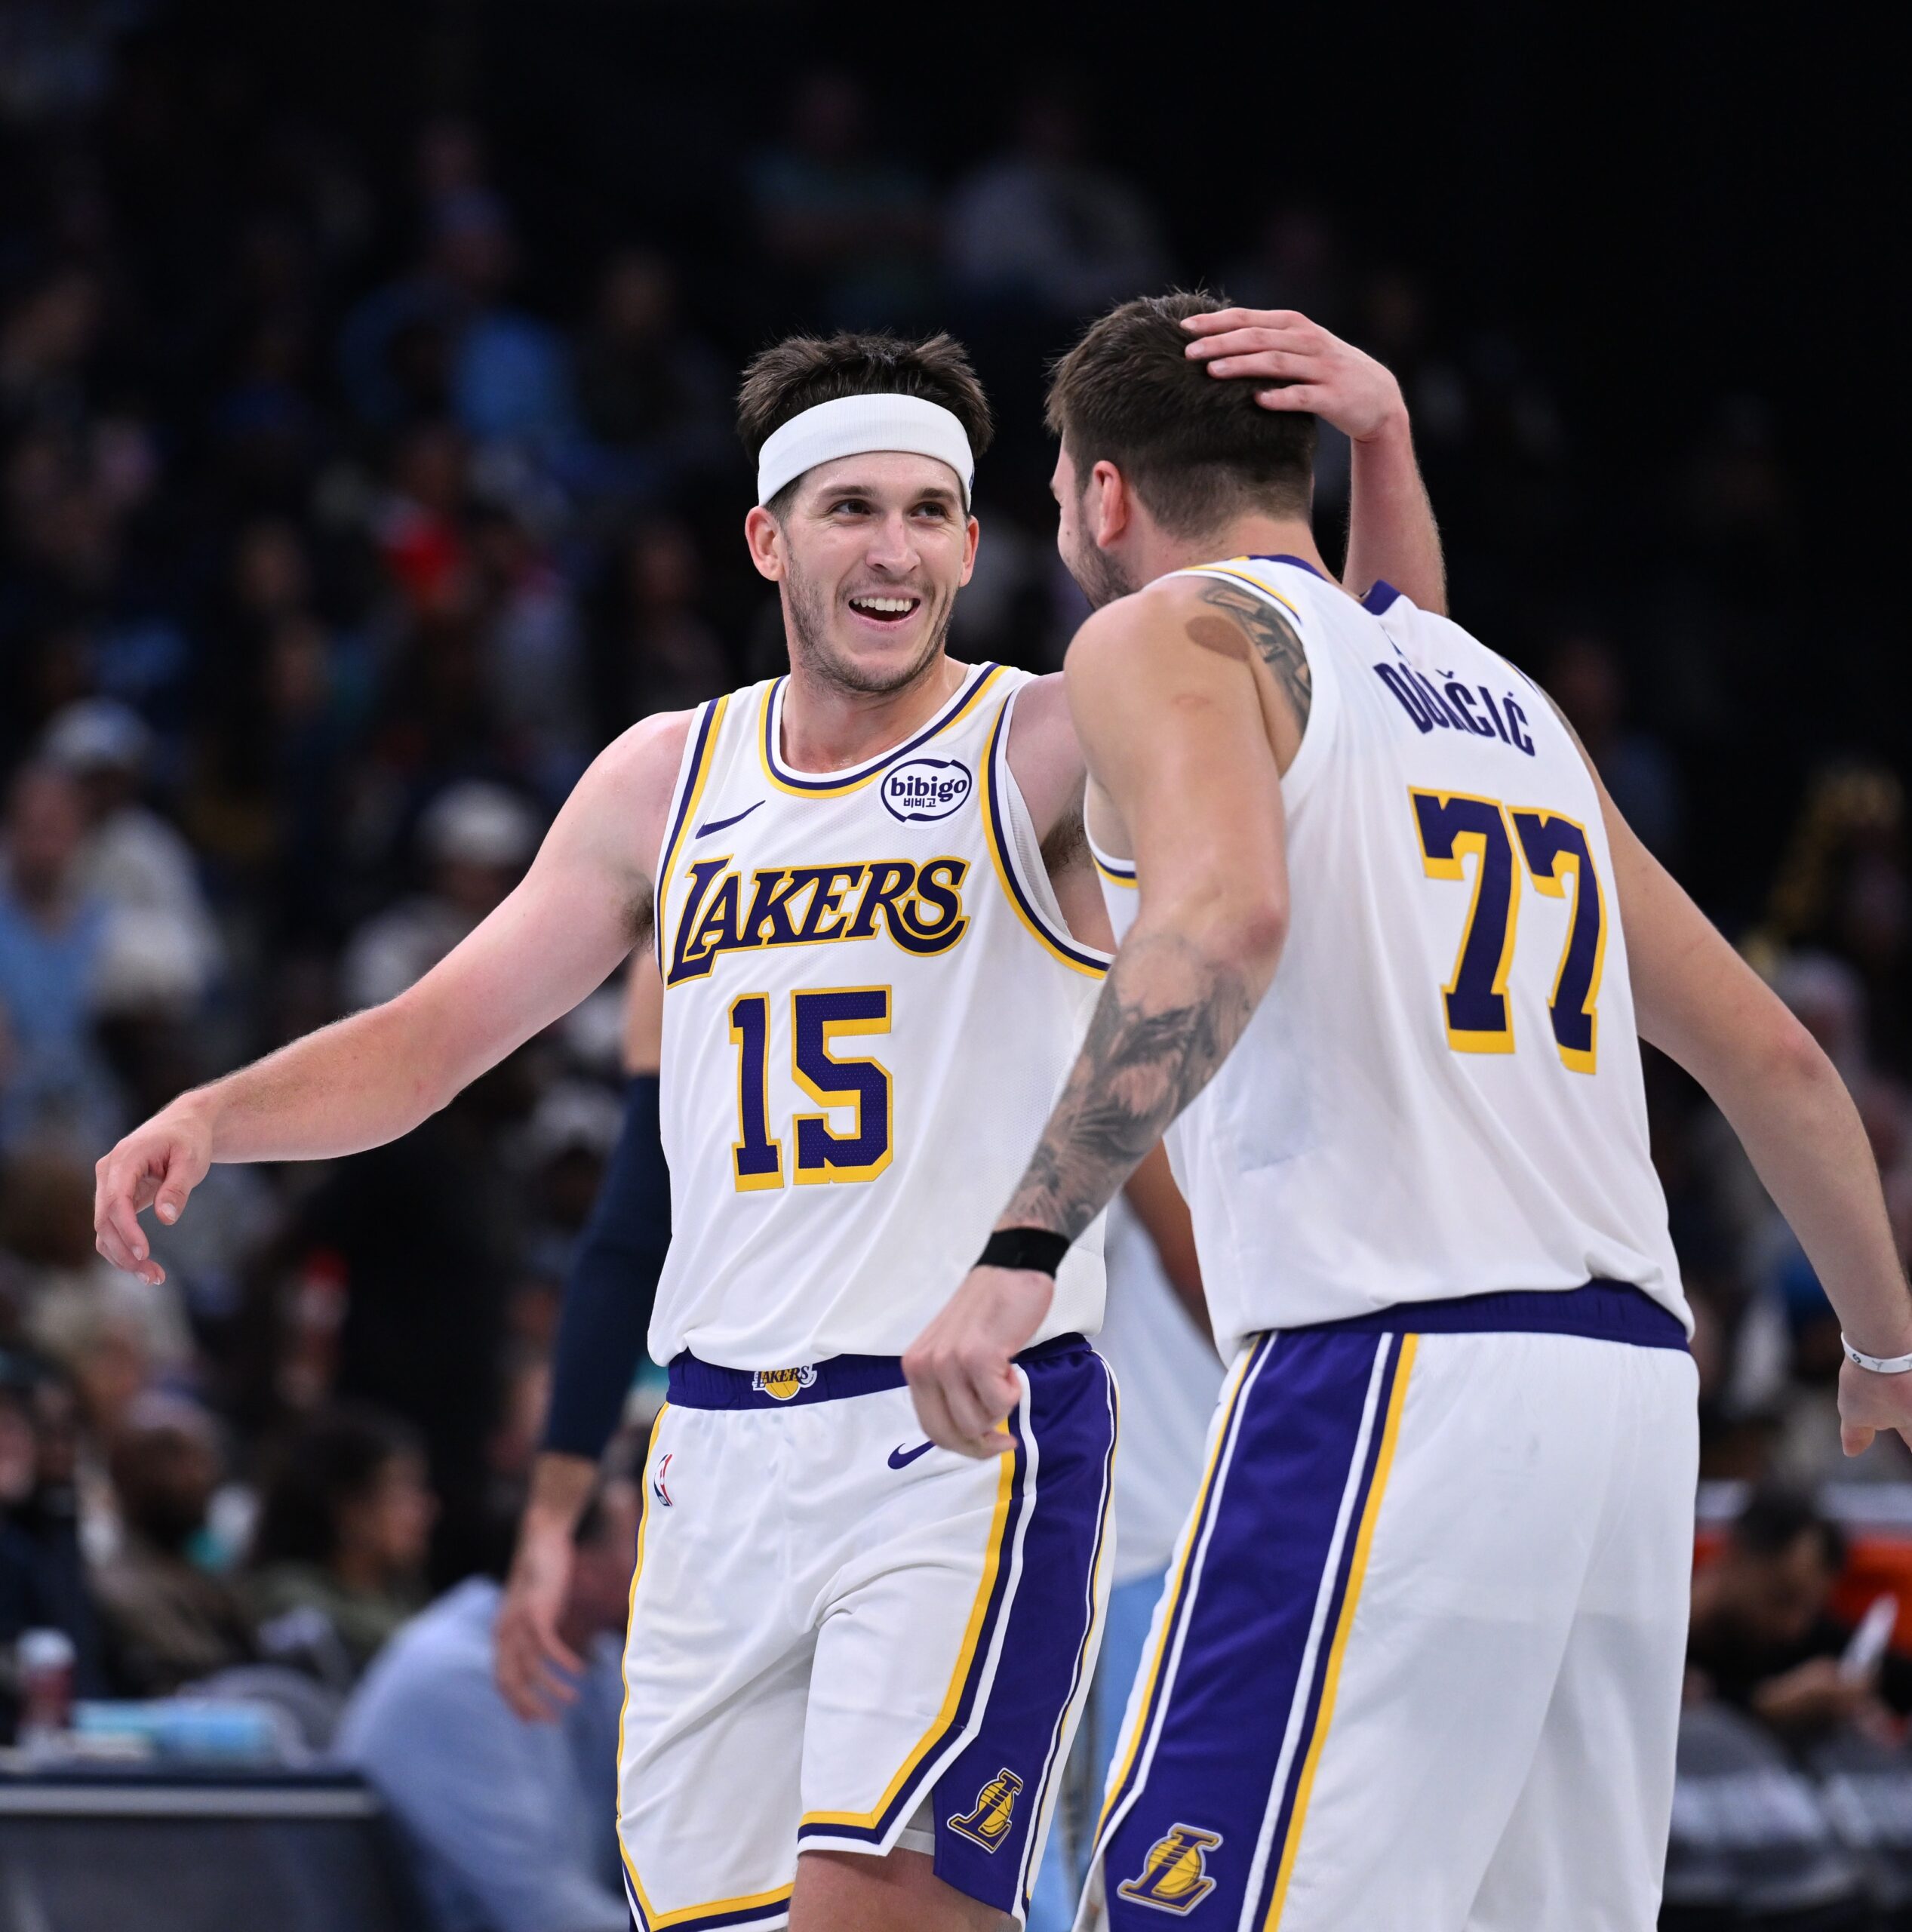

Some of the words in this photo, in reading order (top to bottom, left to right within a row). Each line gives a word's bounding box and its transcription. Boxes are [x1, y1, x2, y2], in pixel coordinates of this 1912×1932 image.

[890, 775, 967, 802] bibigo
[903, 798, 936, 808] 비비고
[667, 854, 970, 990] LAKERS
[1407, 785, 1606, 1075] 77
[728, 985, 893, 1192] 15
[753, 1365, 815, 1389] LAKERS
